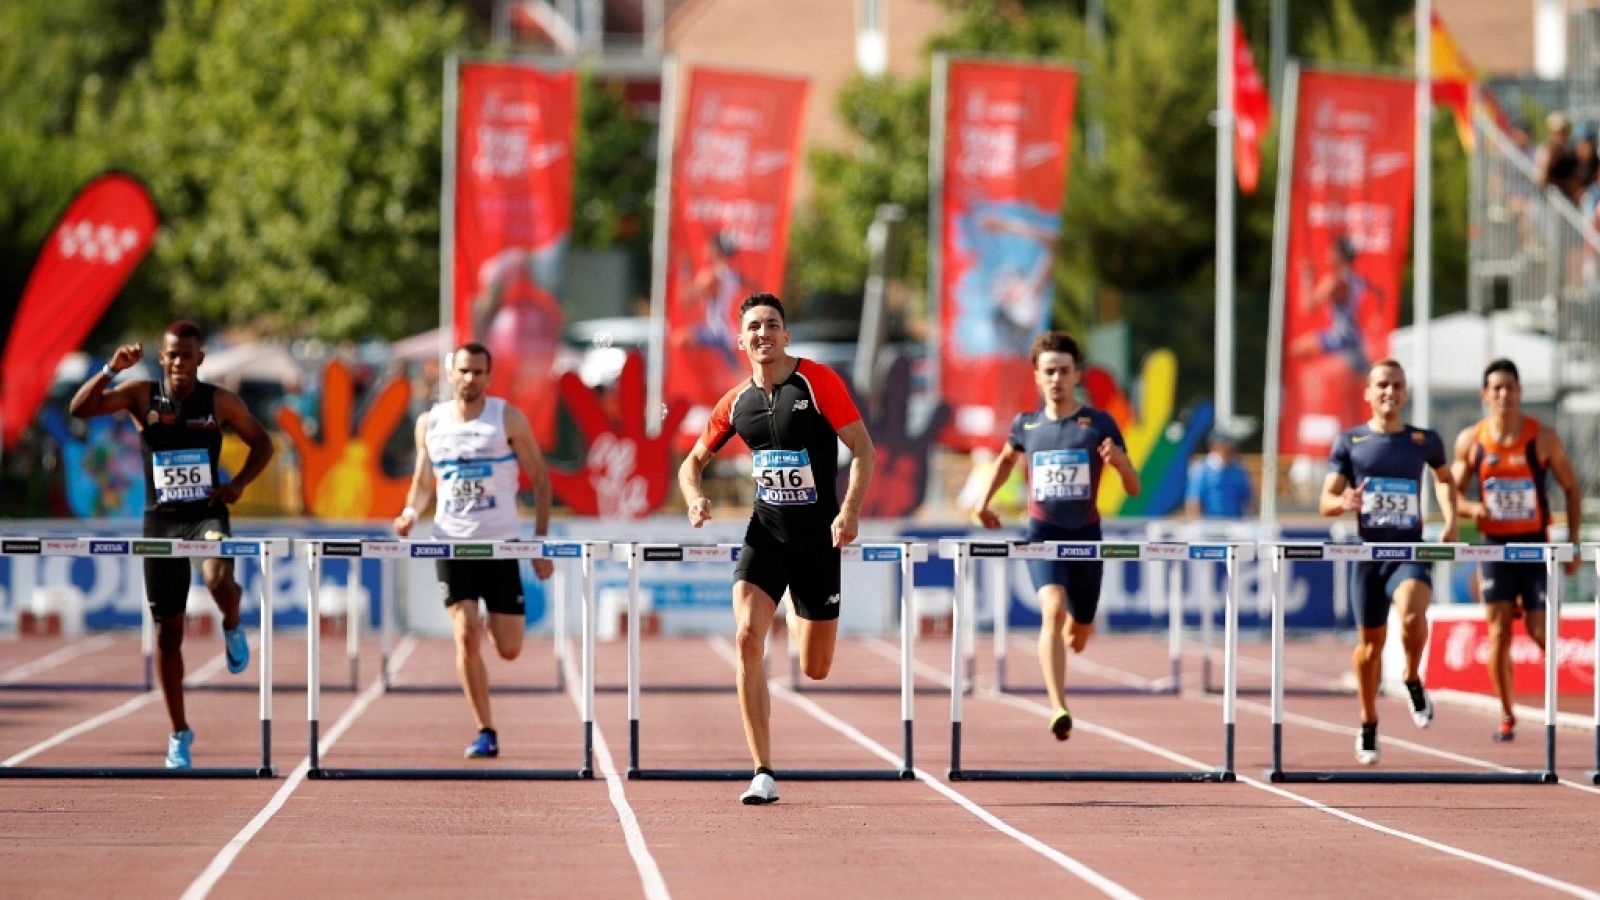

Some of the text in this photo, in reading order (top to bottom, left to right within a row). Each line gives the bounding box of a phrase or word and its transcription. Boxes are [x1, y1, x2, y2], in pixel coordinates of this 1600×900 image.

[164, 466, 201, 485] 556
[762, 469, 802, 488] 516
[1045, 466, 1078, 484] 367
[159, 486, 206, 502] Joma
[762, 488, 809, 501] Joma
[1374, 494, 1409, 511] 353
[1060, 547, 1092, 557] Joma
